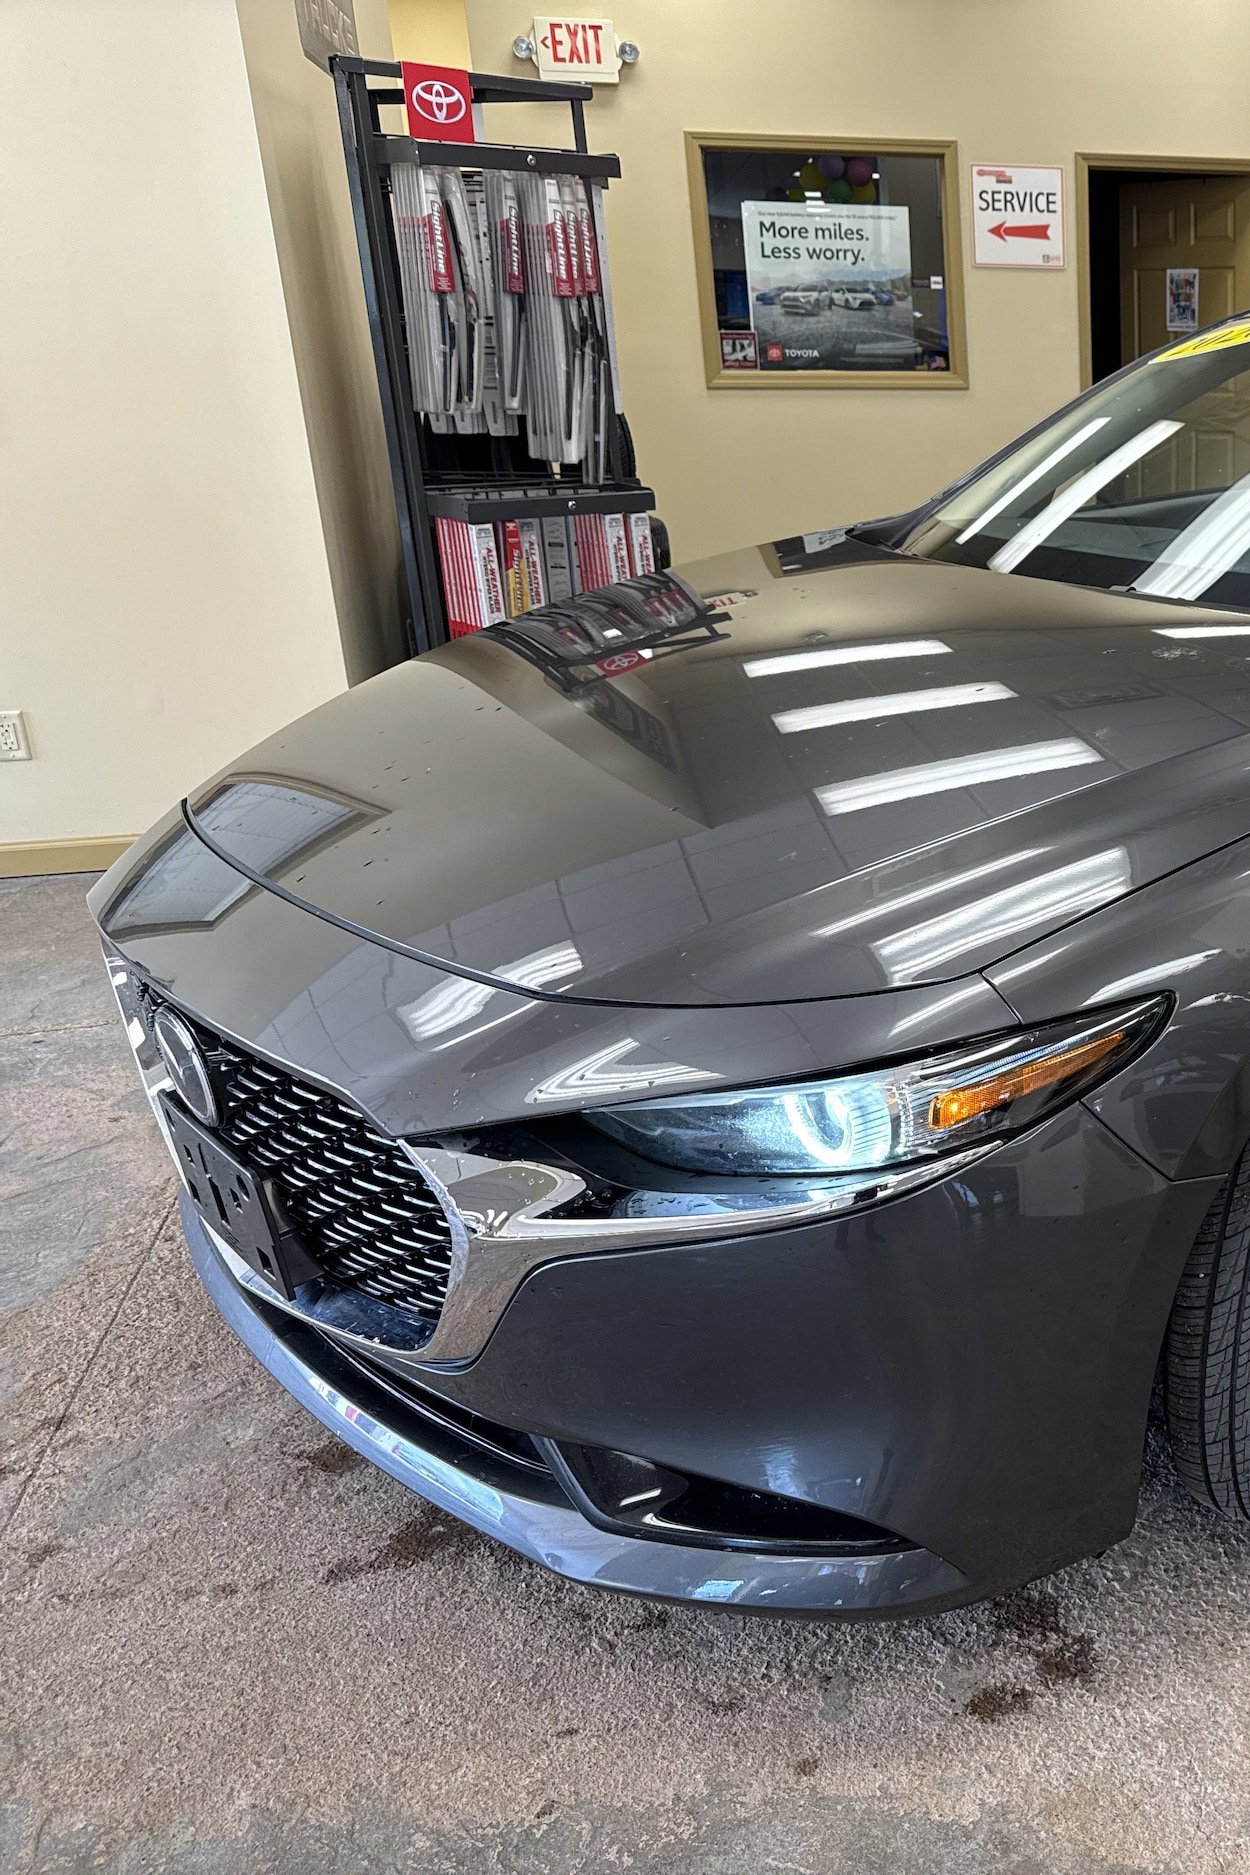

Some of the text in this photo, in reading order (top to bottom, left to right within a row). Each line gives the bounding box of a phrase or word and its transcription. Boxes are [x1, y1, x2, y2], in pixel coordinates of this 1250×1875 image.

[549, 23, 603, 65] EXIT
[978, 189, 1057, 214] SERVICE
[759, 221, 870, 242] More miles.
[760, 242, 865, 265] Less worry.
[784, 349, 820, 358] TOYOTA
[527, 540, 542, 604] ALL-WEATHER
[616, 535, 628, 580] ALL-WEAT
[641, 534, 653, 575] ALL-WEA
[486, 547, 502, 613] ALL-WEATHER
